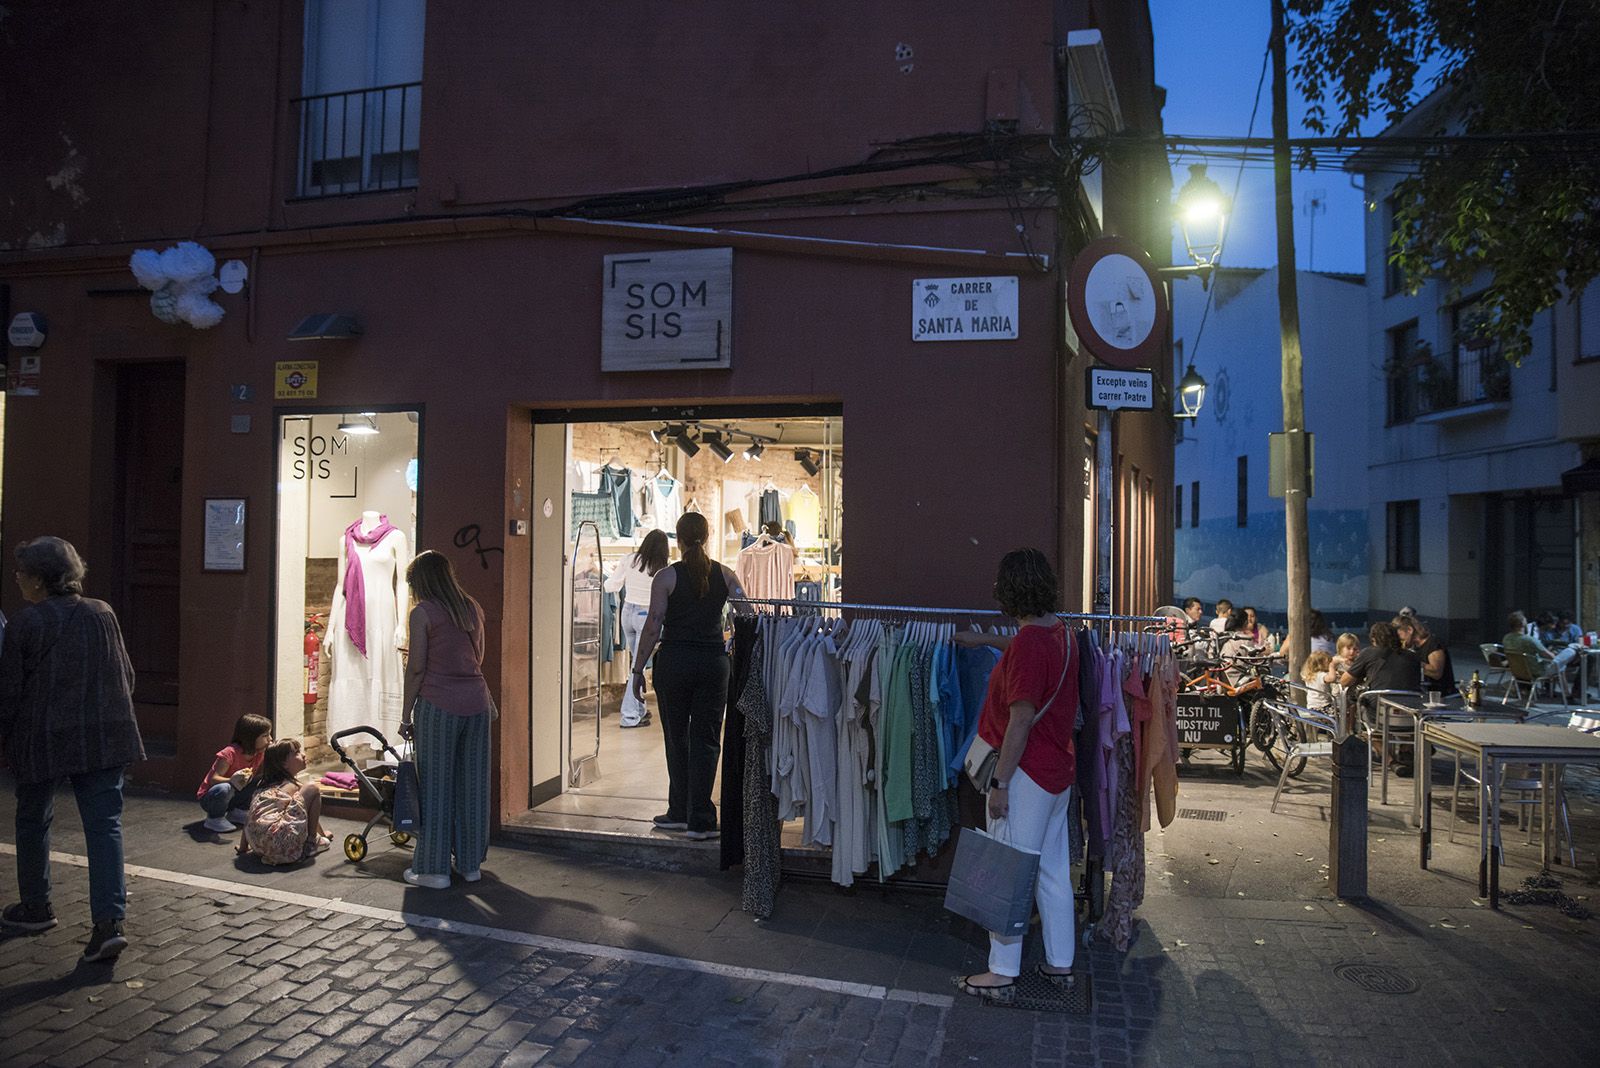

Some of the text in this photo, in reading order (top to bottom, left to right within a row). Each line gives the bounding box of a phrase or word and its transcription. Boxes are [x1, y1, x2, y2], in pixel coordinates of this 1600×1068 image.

[626, 280, 707, 309] SOM
[951, 282, 992, 295] CARRER
[965, 299, 979, 311] DE
[625, 312, 682, 340] SIS
[918, 316, 1012, 334] SANTA MARIA
[1096, 376, 1148, 388] Excepte veïns
[239, 384, 247, 400] 2
[1098, 392, 1122, 401] carrer
[293, 435, 347, 456] SOM
[293, 459, 331, 480] SIS
[1207, 707, 1223, 718] TIL
[1184, 730, 1201, 743] NU
